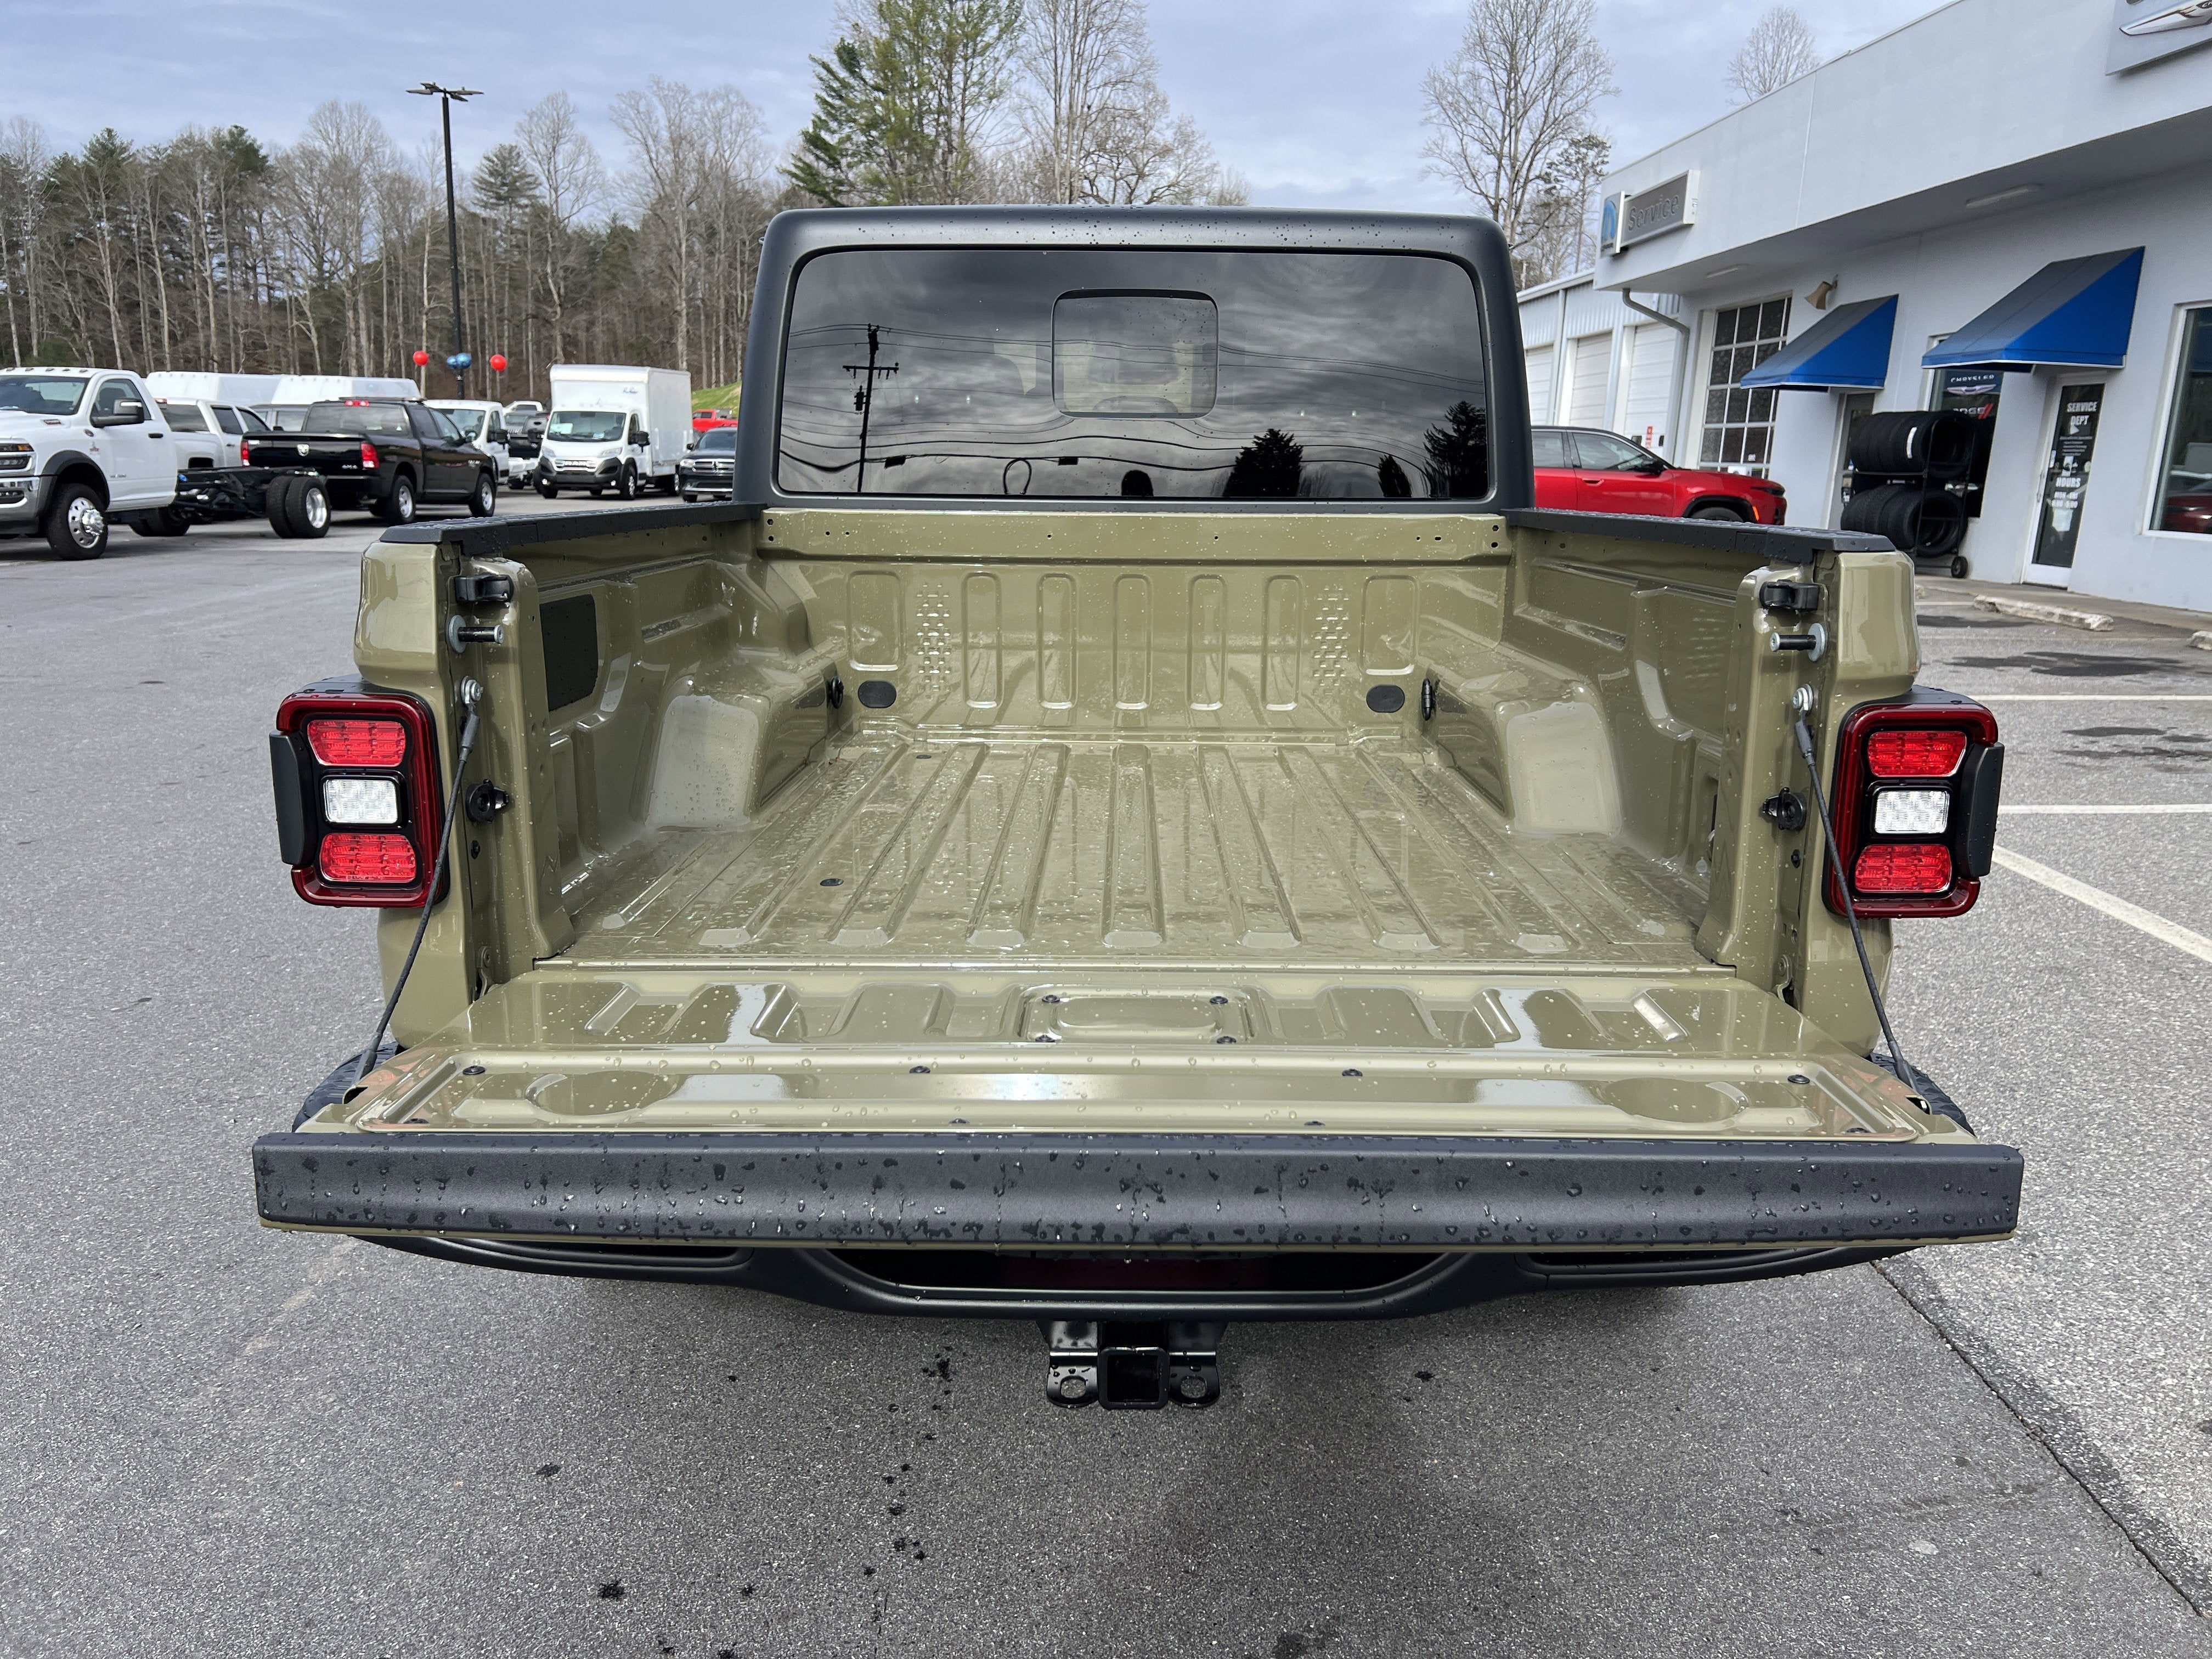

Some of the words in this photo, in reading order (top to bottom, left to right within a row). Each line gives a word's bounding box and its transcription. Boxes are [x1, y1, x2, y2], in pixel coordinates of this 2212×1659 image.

[1628, 194, 1679, 232] Service
[2067, 401, 2098, 412] SERVICE
[2070, 415, 2090, 425] DEPT
[2056, 477, 2081, 488] HOURS
